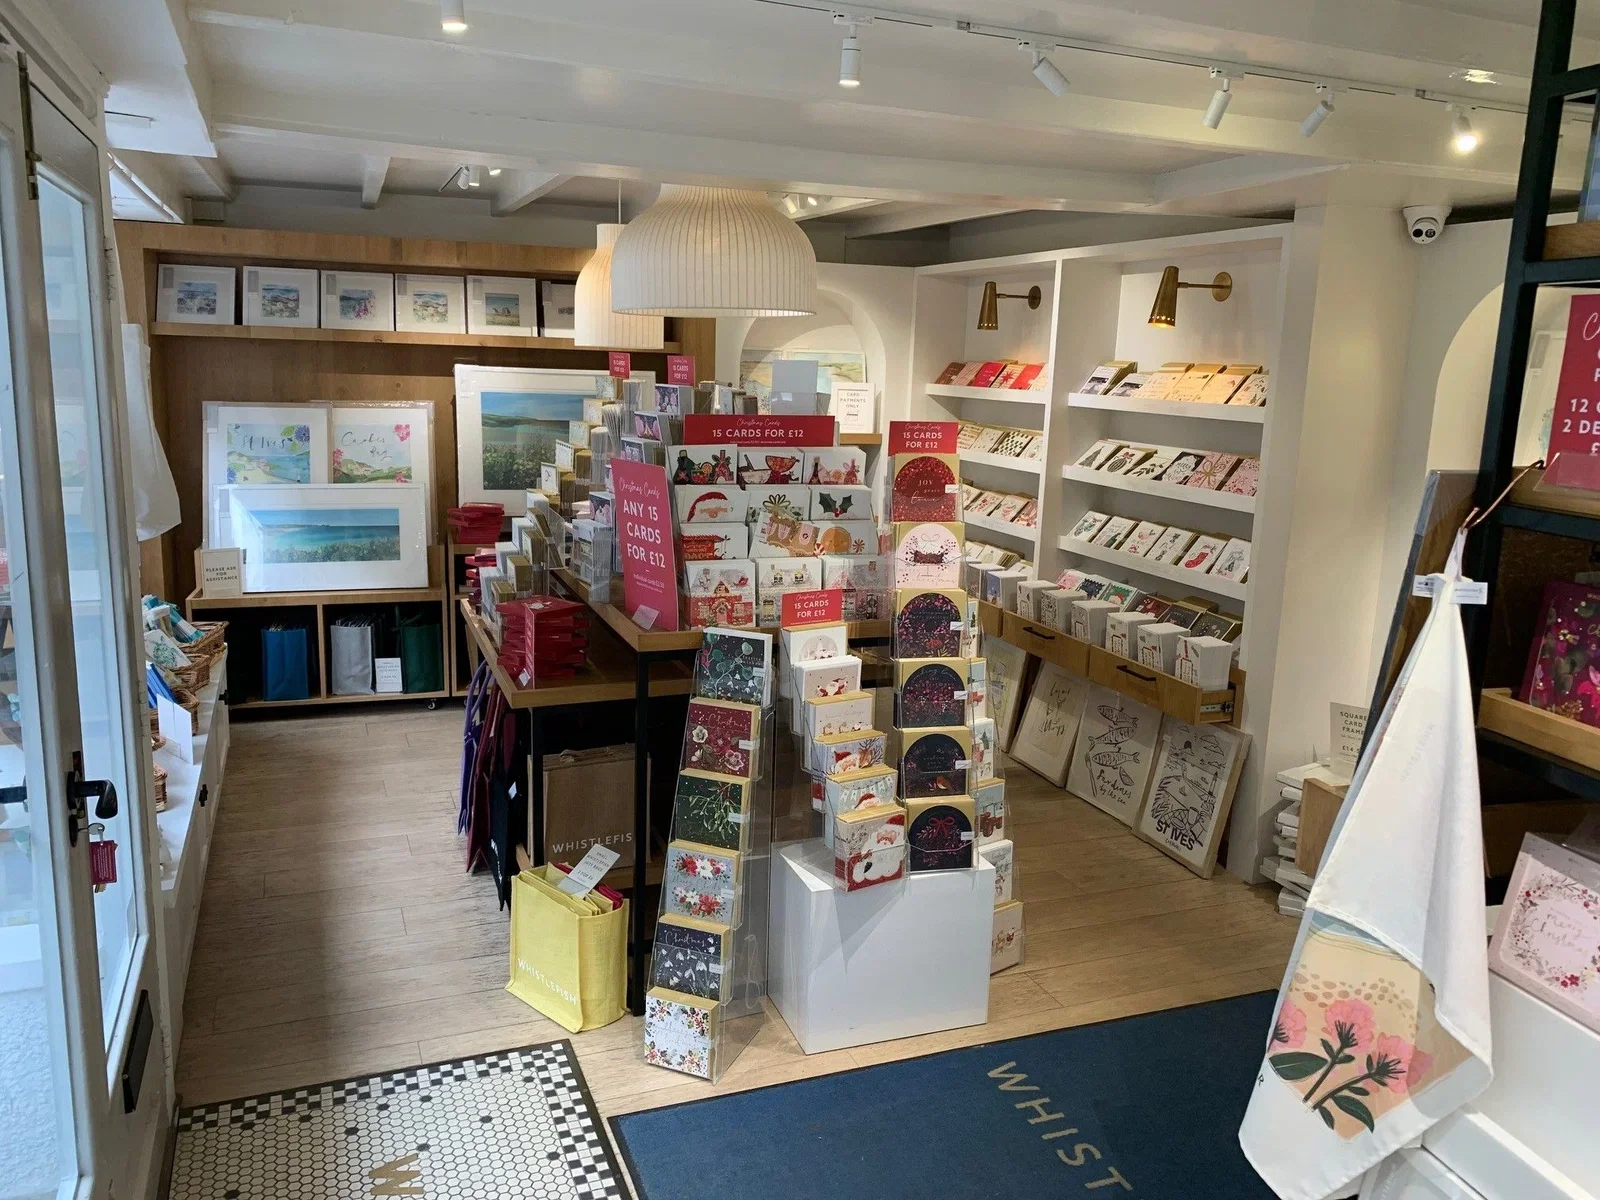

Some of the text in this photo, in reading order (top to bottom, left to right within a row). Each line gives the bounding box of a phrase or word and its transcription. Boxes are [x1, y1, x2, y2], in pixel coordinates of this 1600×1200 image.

[1570, 398, 1588, 413] 12
[736, 418, 781, 427] Christmas Cards
[1562, 419, 1572, 433] 2
[712, 428, 804, 438] 15 CARDS FOR £12
[619, 476, 660, 499] Christmas Cards
[623, 500, 658, 522] ANY 15
[626, 522, 662, 545] CARDS
[627, 543, 666, 569] FOR £12
[804, 600, 829, 608] CARDS
[1340, 712, 1368, 721] SQUARE
[1156, 820, 1195, 851] ST IVES
[666, 932, 705, 948] Christmas
[517, 957, 578, 1005] WHISTLEFISH
[987, 1061, 1133, 1191] WHIST
